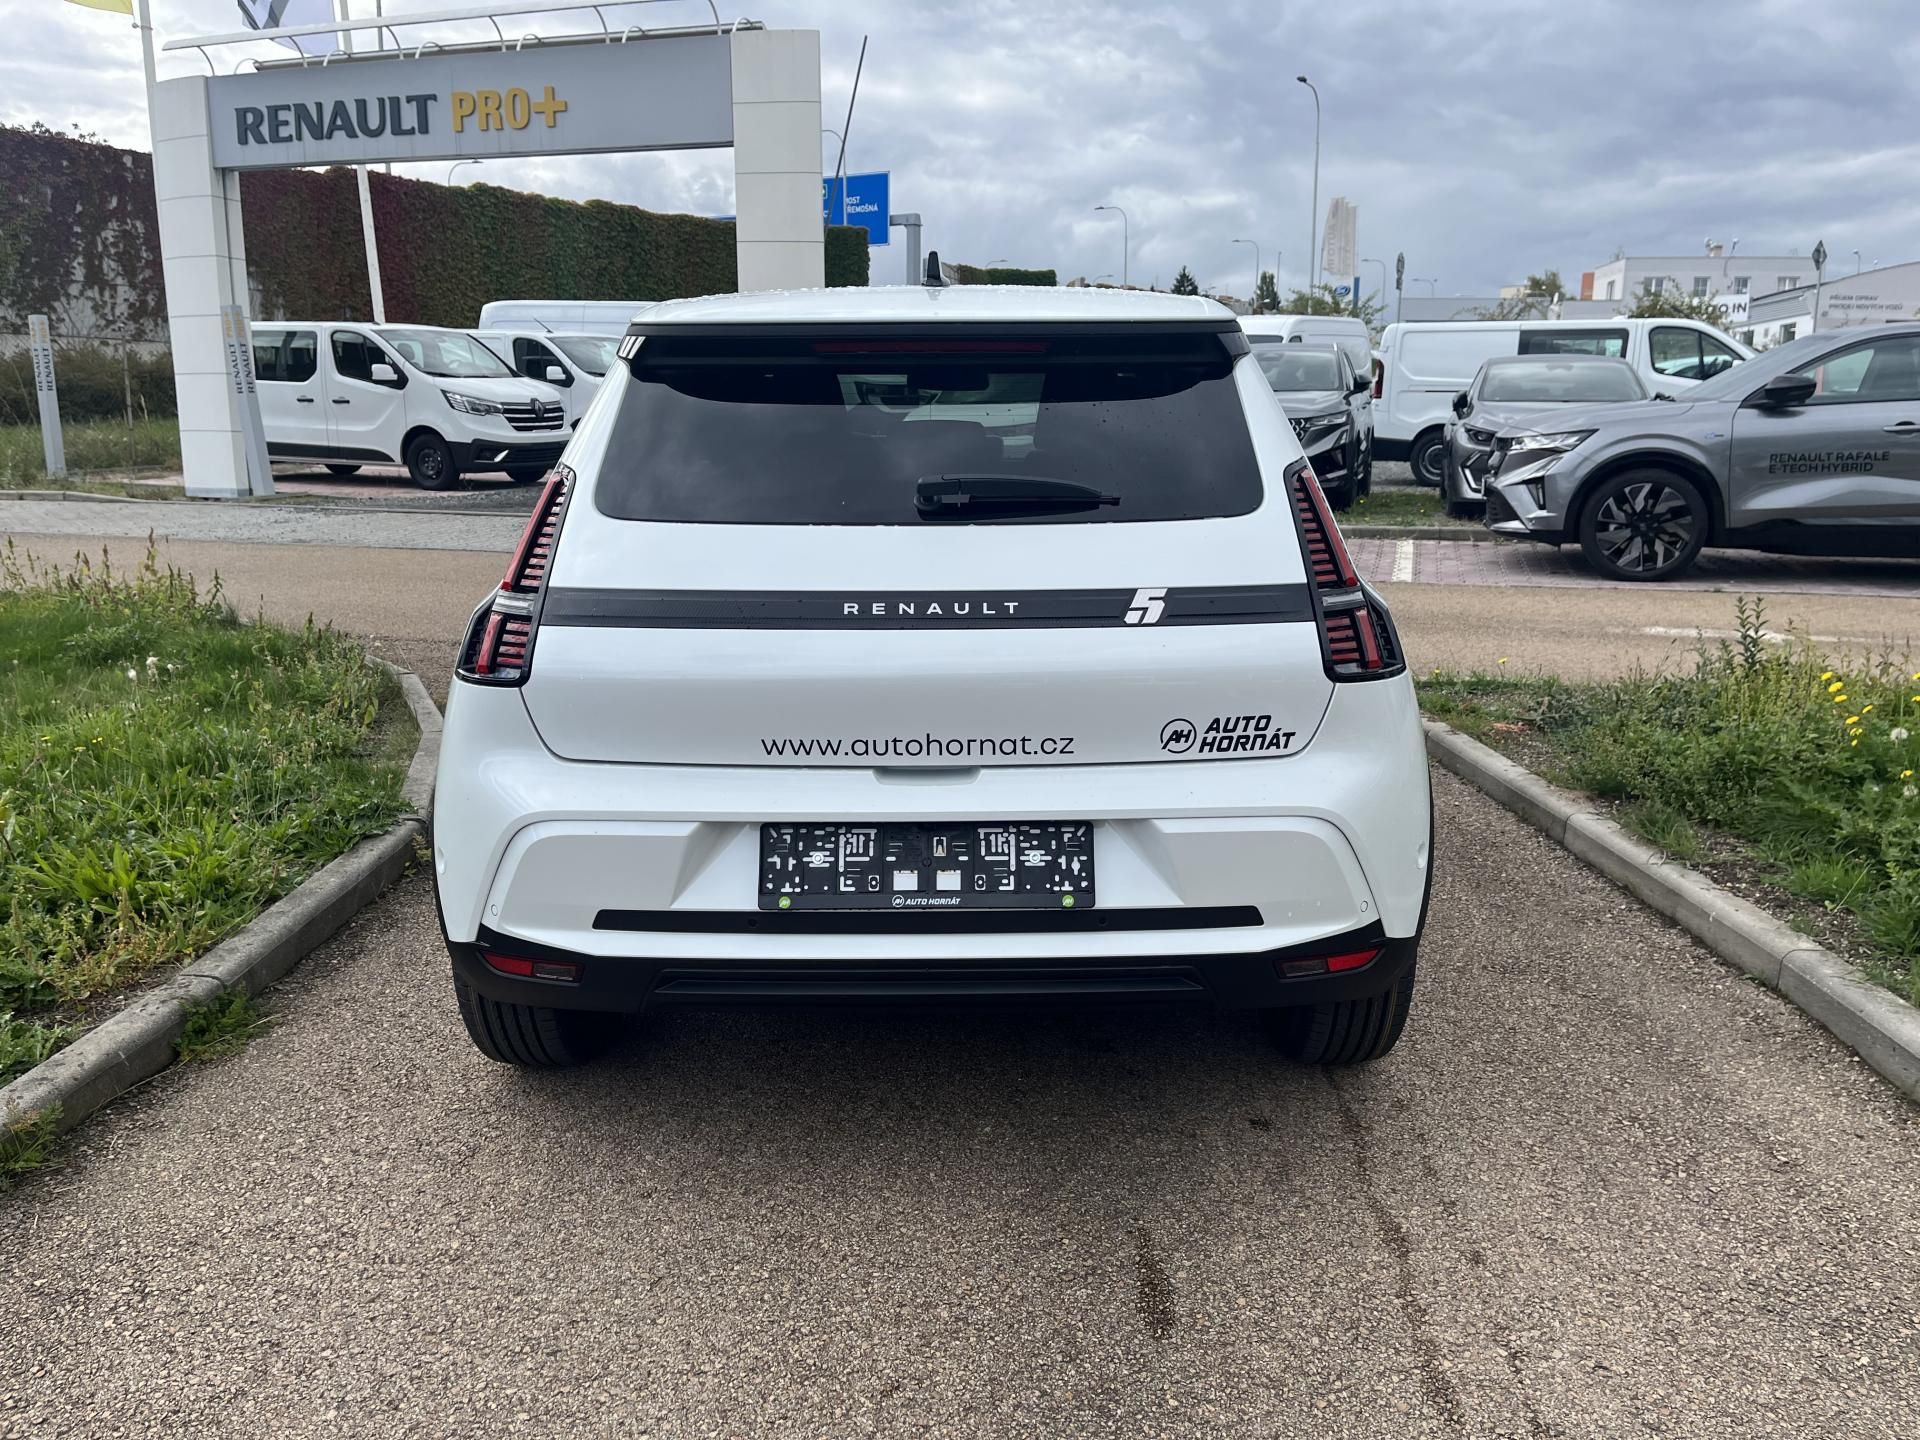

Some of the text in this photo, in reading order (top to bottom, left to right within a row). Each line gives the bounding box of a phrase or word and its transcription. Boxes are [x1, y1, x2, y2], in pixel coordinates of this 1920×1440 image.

[234, 84, 568, 145] RENAULT PRO+
[846, 202, 878, 213] ŘEMOŠNÁ
[42, 346, 54, 392] RENAULT
[228, 343, 244, 394] RENAULT
[239, 342, 255, 394] RENAULT
[1768, 462, 1874, 474] E-TECH HYBRID
[1769, 450, 1890, 464] RENAULT RAFALE
[843, 588, 1168, 625] RENAULT 5
[1204, 715, 1272, 735] AUTO
[760, 733, 1075, 756] www.autohornat.cz
[1198, 728, 1296, 753] HORNÁT
[904, 898, 927, 906] AUTO
[928, 896, 961, 906] HORNÁT
